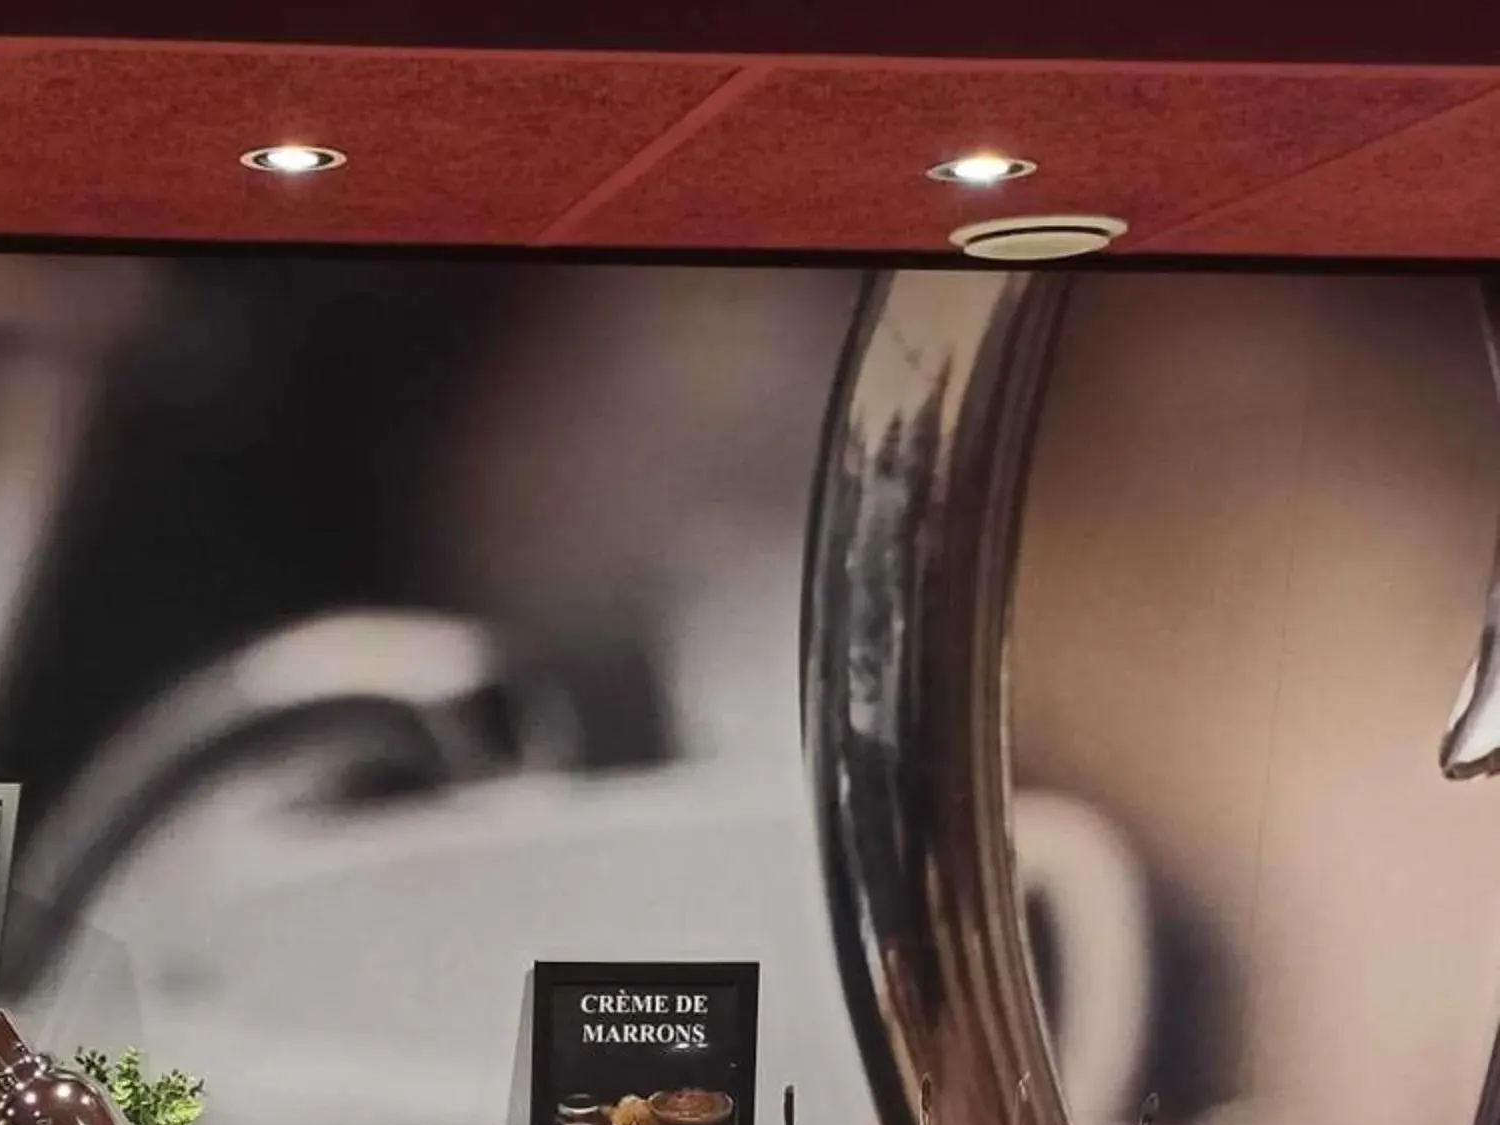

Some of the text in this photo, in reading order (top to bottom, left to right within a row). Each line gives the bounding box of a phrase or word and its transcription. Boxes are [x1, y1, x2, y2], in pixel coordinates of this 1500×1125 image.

[580, 988, 708, 1013] CRÈME DE
[582, 1023, 706, 1043] MARRONS
